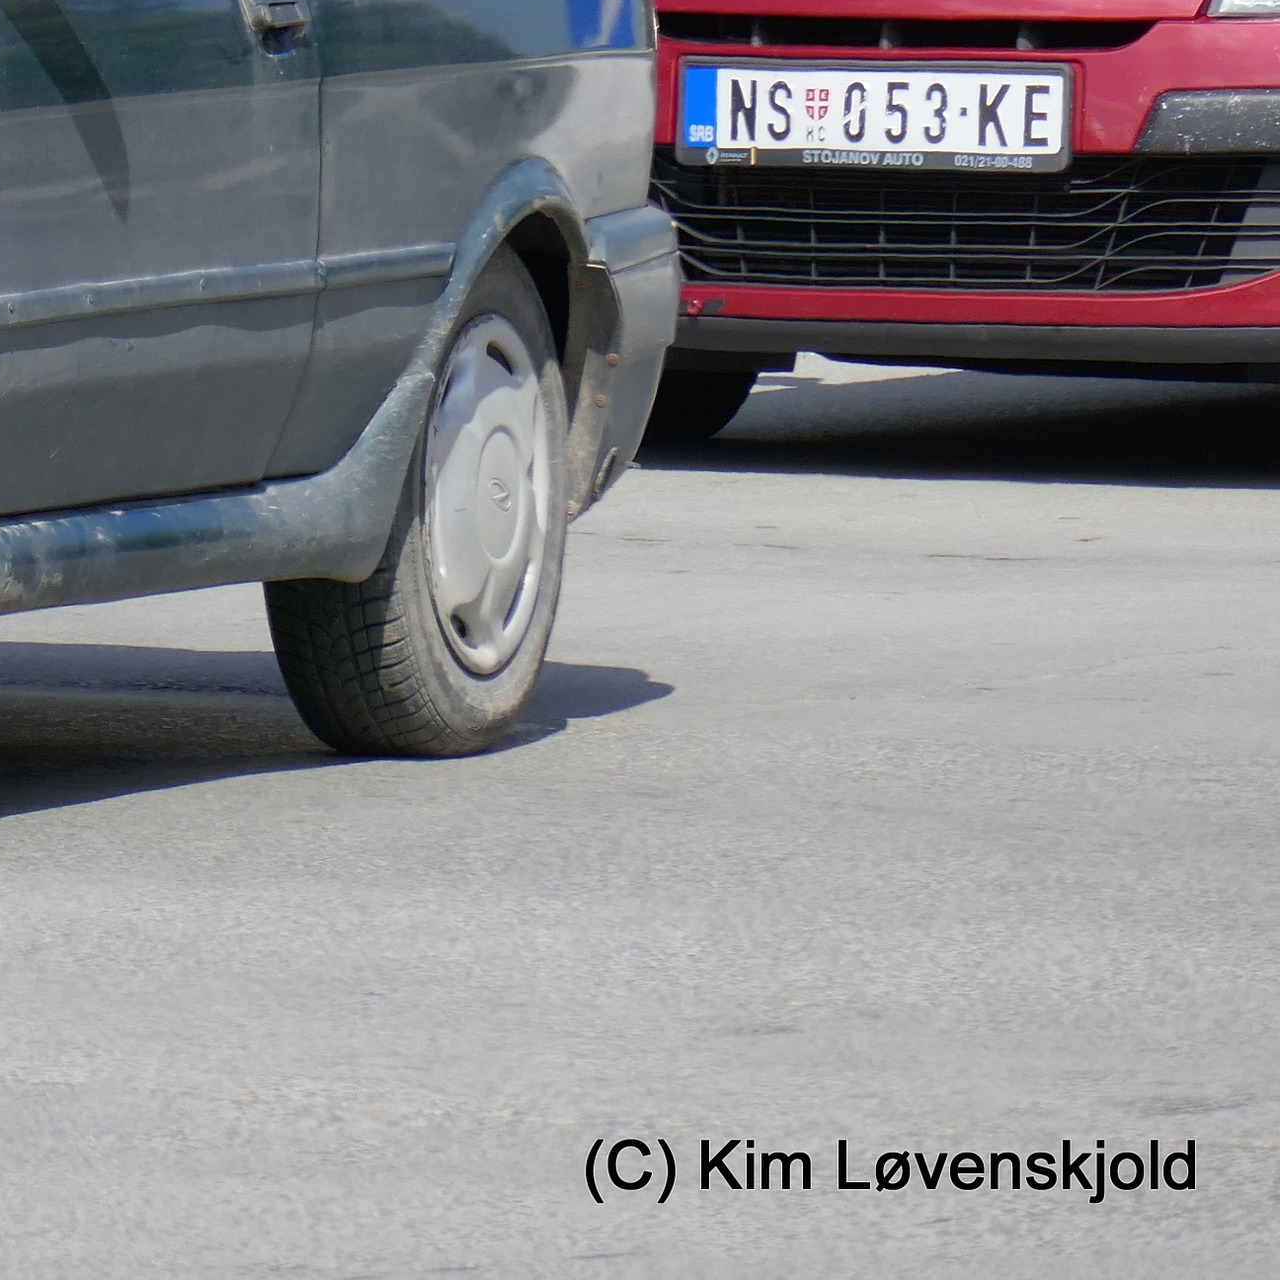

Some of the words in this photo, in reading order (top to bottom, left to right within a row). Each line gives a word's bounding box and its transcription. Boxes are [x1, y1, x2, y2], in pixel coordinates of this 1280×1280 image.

[730, 78, 793, 142] NS
[689, 124, 714, 143] SRB
[802, 150, 880, 166] STOJANOV
[883, 151, 924, 167] AUTO
